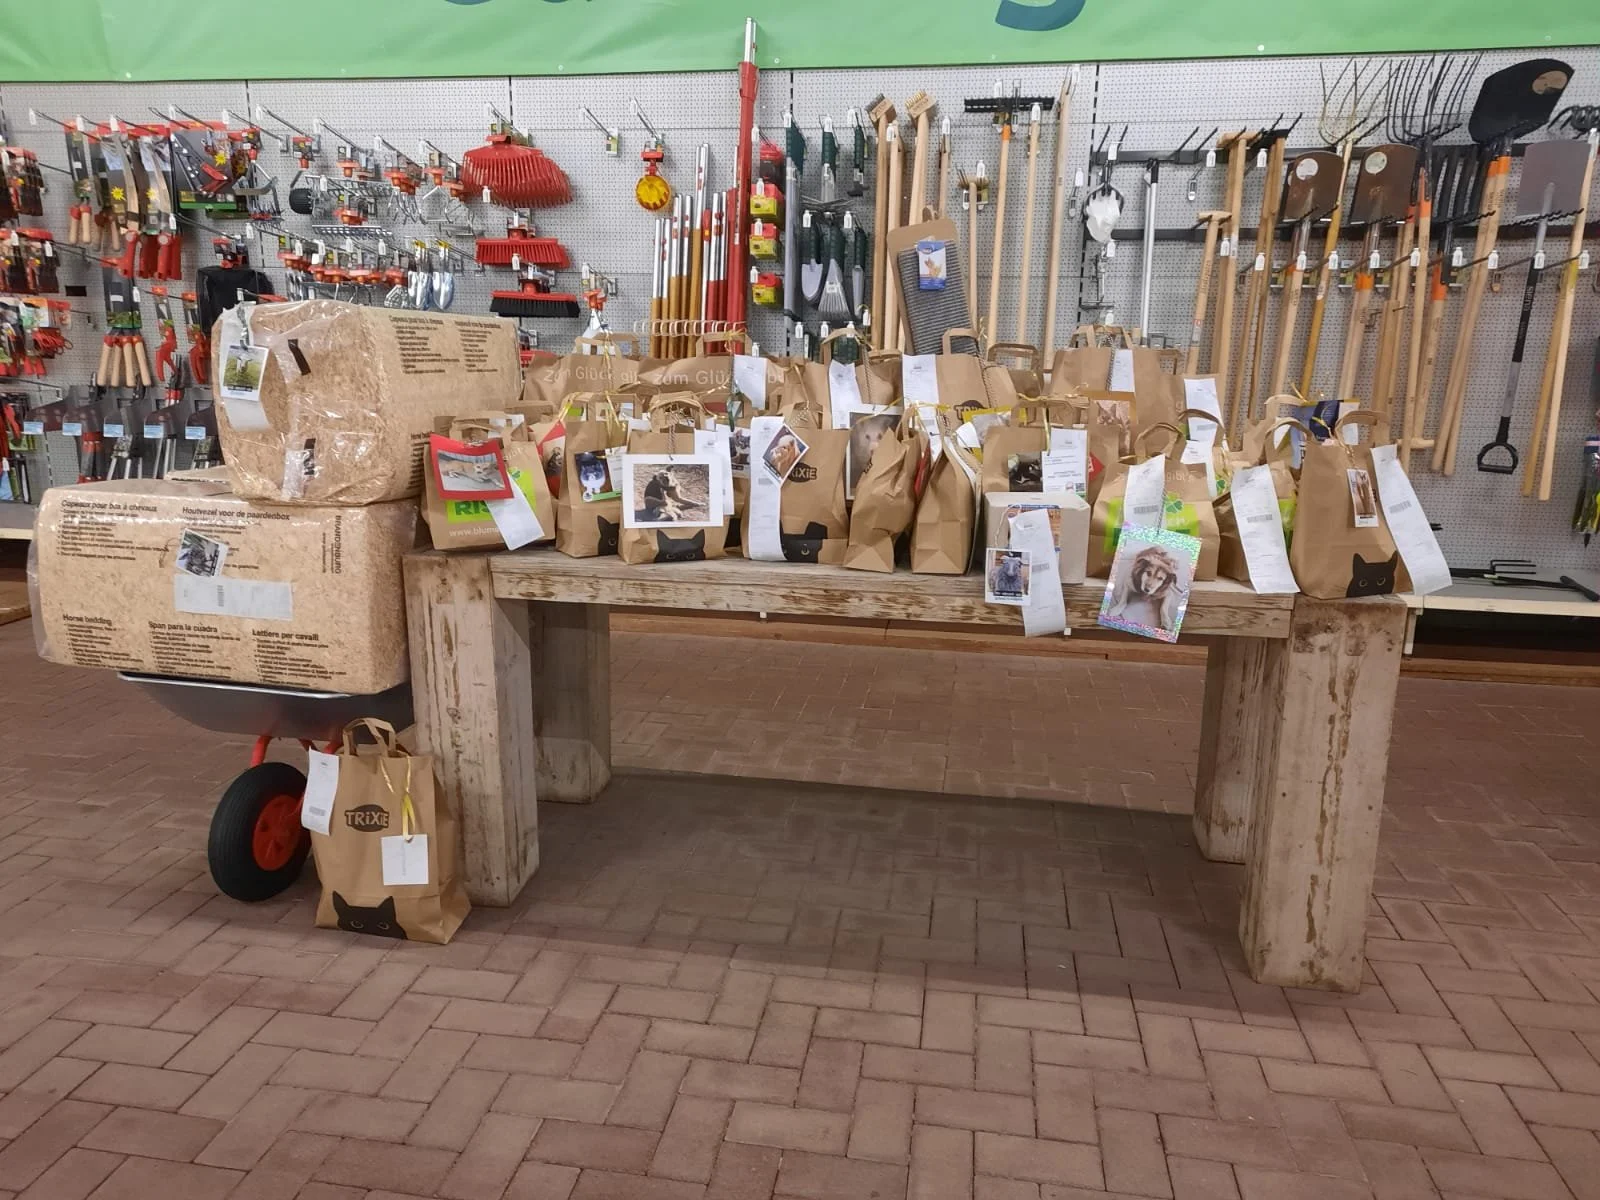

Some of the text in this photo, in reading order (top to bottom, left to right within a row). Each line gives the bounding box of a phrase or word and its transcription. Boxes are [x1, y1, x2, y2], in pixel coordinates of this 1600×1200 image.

[219, 509, 234, 518] voor
[236, 509, 246, 518] de
[247, 511, 290, 521] paardenbox
[281, 632, 293, 640] per
